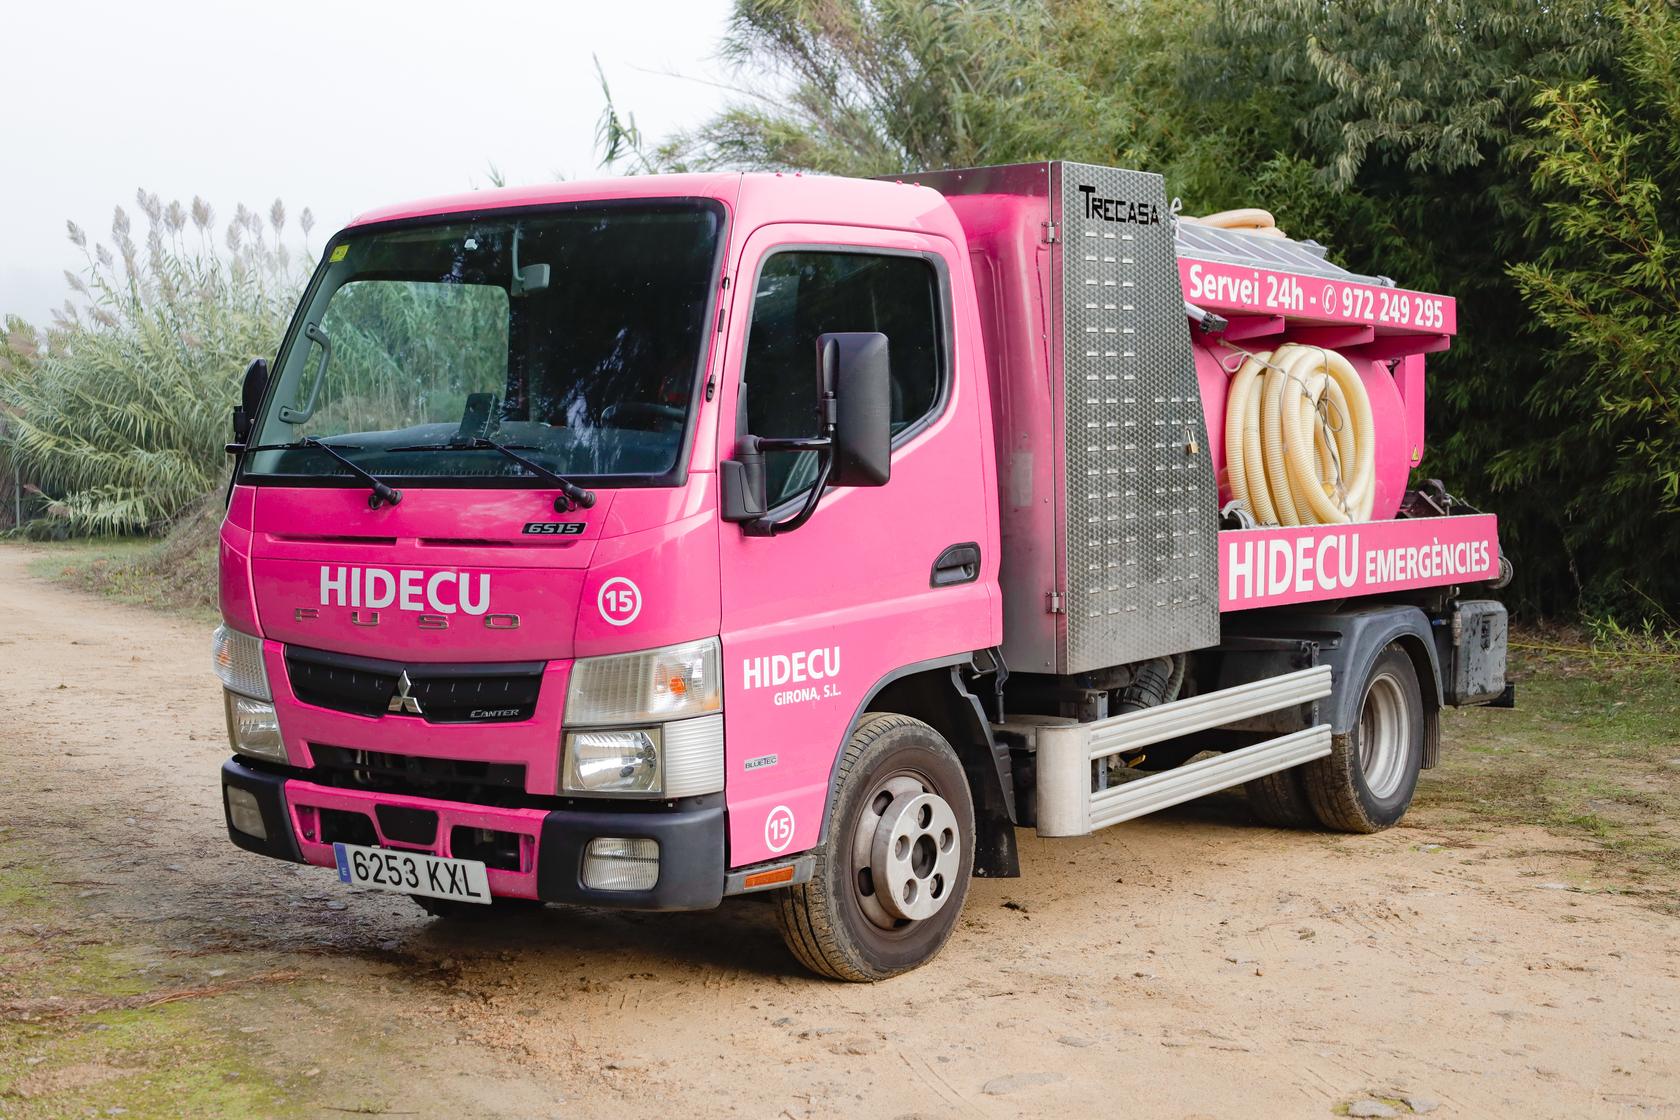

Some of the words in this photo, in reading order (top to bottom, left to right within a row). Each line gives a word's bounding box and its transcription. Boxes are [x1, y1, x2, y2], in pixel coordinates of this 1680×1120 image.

[1079, 185, 1160, 225] TRECASA
[1189, 264, 1260, 305] Servei
[1266, 275, 1304, 310] 24h
[1342, 287, 1375, 320] 972
[1379, 292, 1410, 324] 249
[1414, 297, 1443, 328] 295
[527, 523, 580, 533] 6S15
[1228, 534, 1360, 600] HIDECU
[1365, 537, 1490, 584] EMERGÈNCIES
[320, 566, 491, 615] HIDECU
[605, 591, 633, 611] 15
[295, 608, 521, 629] FUSO
[743, 646, 840, 689] HIDECU
[774, 688, 820, 705] GIRONA,
[823, 684, 842, 699] S.L.
[470, 709, 520, 718] CANTER
[769, 817, 789, 840] 15
[353, 851, 419, 888] 6253
[426, 860, 481, 897] KXL
